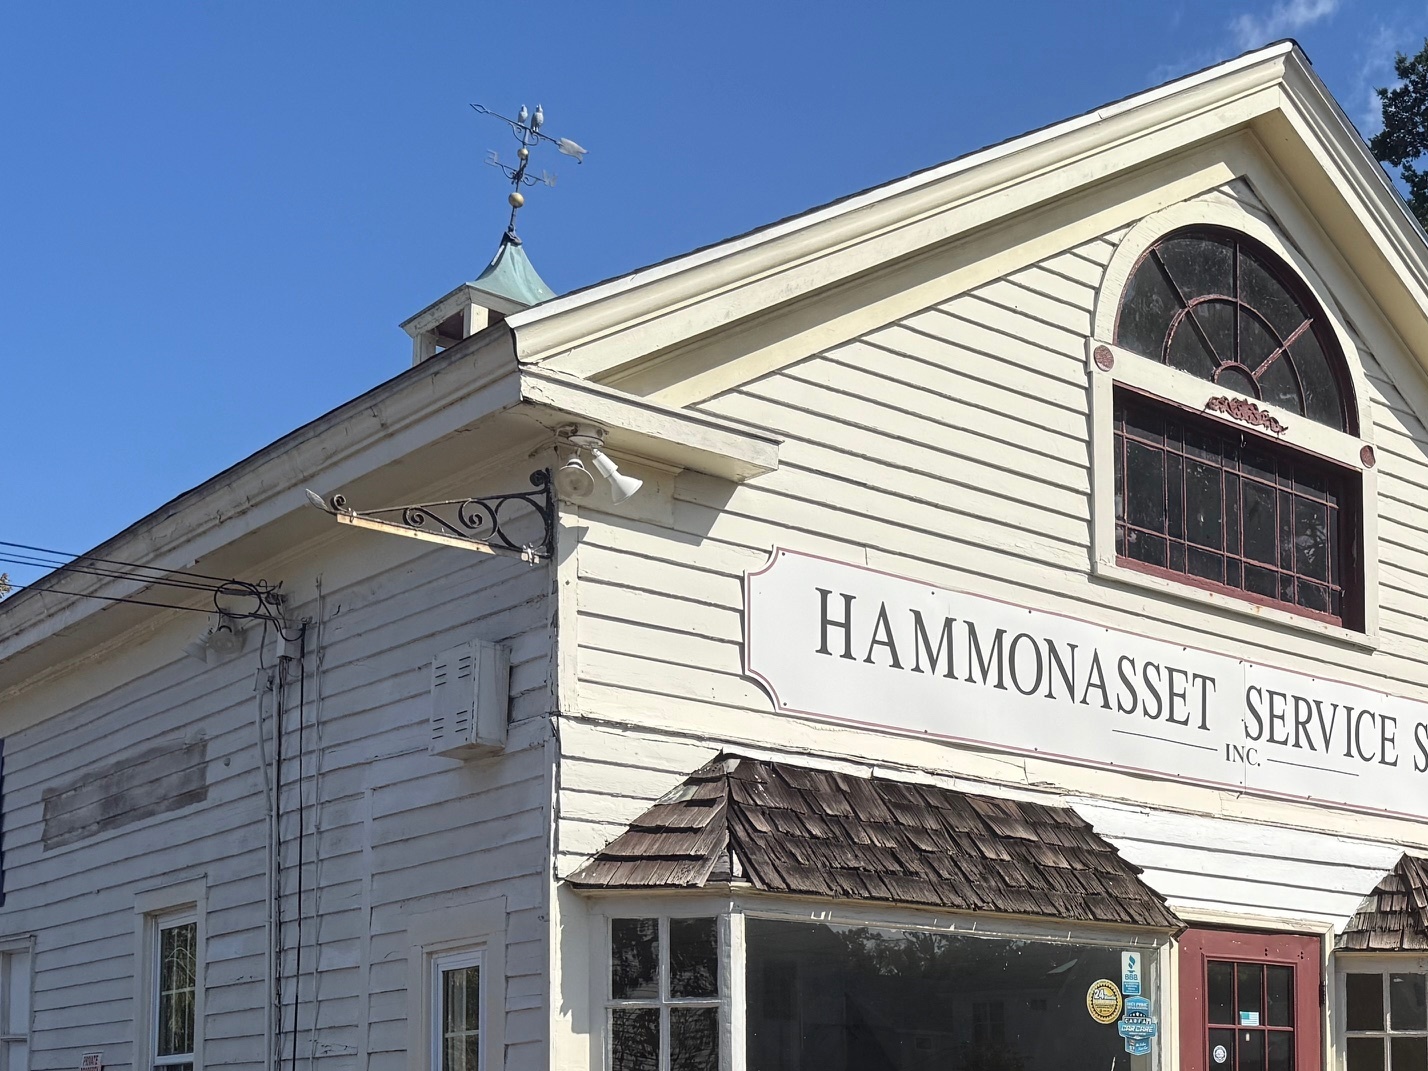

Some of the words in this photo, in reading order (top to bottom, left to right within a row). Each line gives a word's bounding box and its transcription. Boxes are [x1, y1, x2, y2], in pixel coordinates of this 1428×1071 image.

[815, 587, 1216, 731] HAMMONASSET
[1244, 685, 1398, 767] SERVICE
[1225, 743, 1261, 767] INC.
[1124, 973, 1138, 981] BBB
[1094, 988, 1105, 1000] 24
